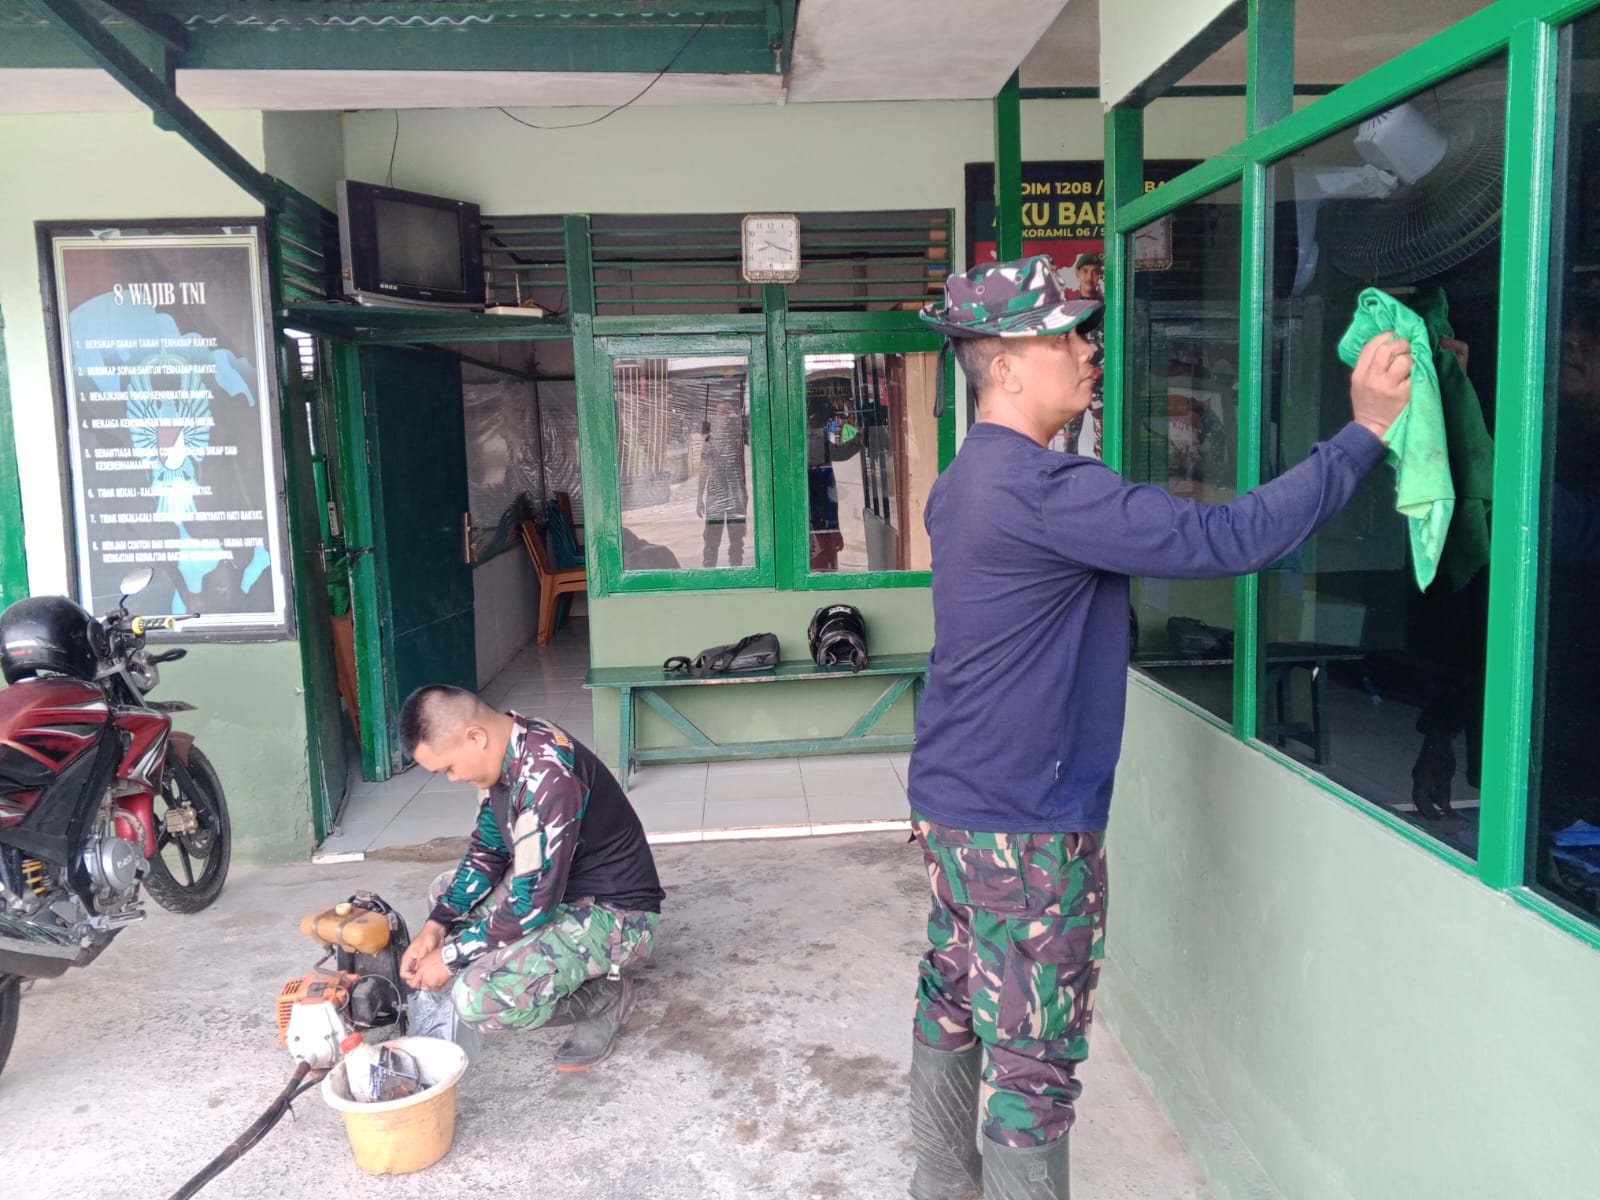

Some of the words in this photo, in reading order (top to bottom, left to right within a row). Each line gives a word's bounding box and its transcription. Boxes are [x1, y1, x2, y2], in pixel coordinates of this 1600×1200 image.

[1055, 182, 1092, 194] 1208
[1022, 228, 1073, 238] KORAMIL
[1076, 227, 1090, 238] 06
[113, 283, 124, 306] 8
[128, 282, 176, 307] WAJIB
[179, 282, 206, 304] TNI
